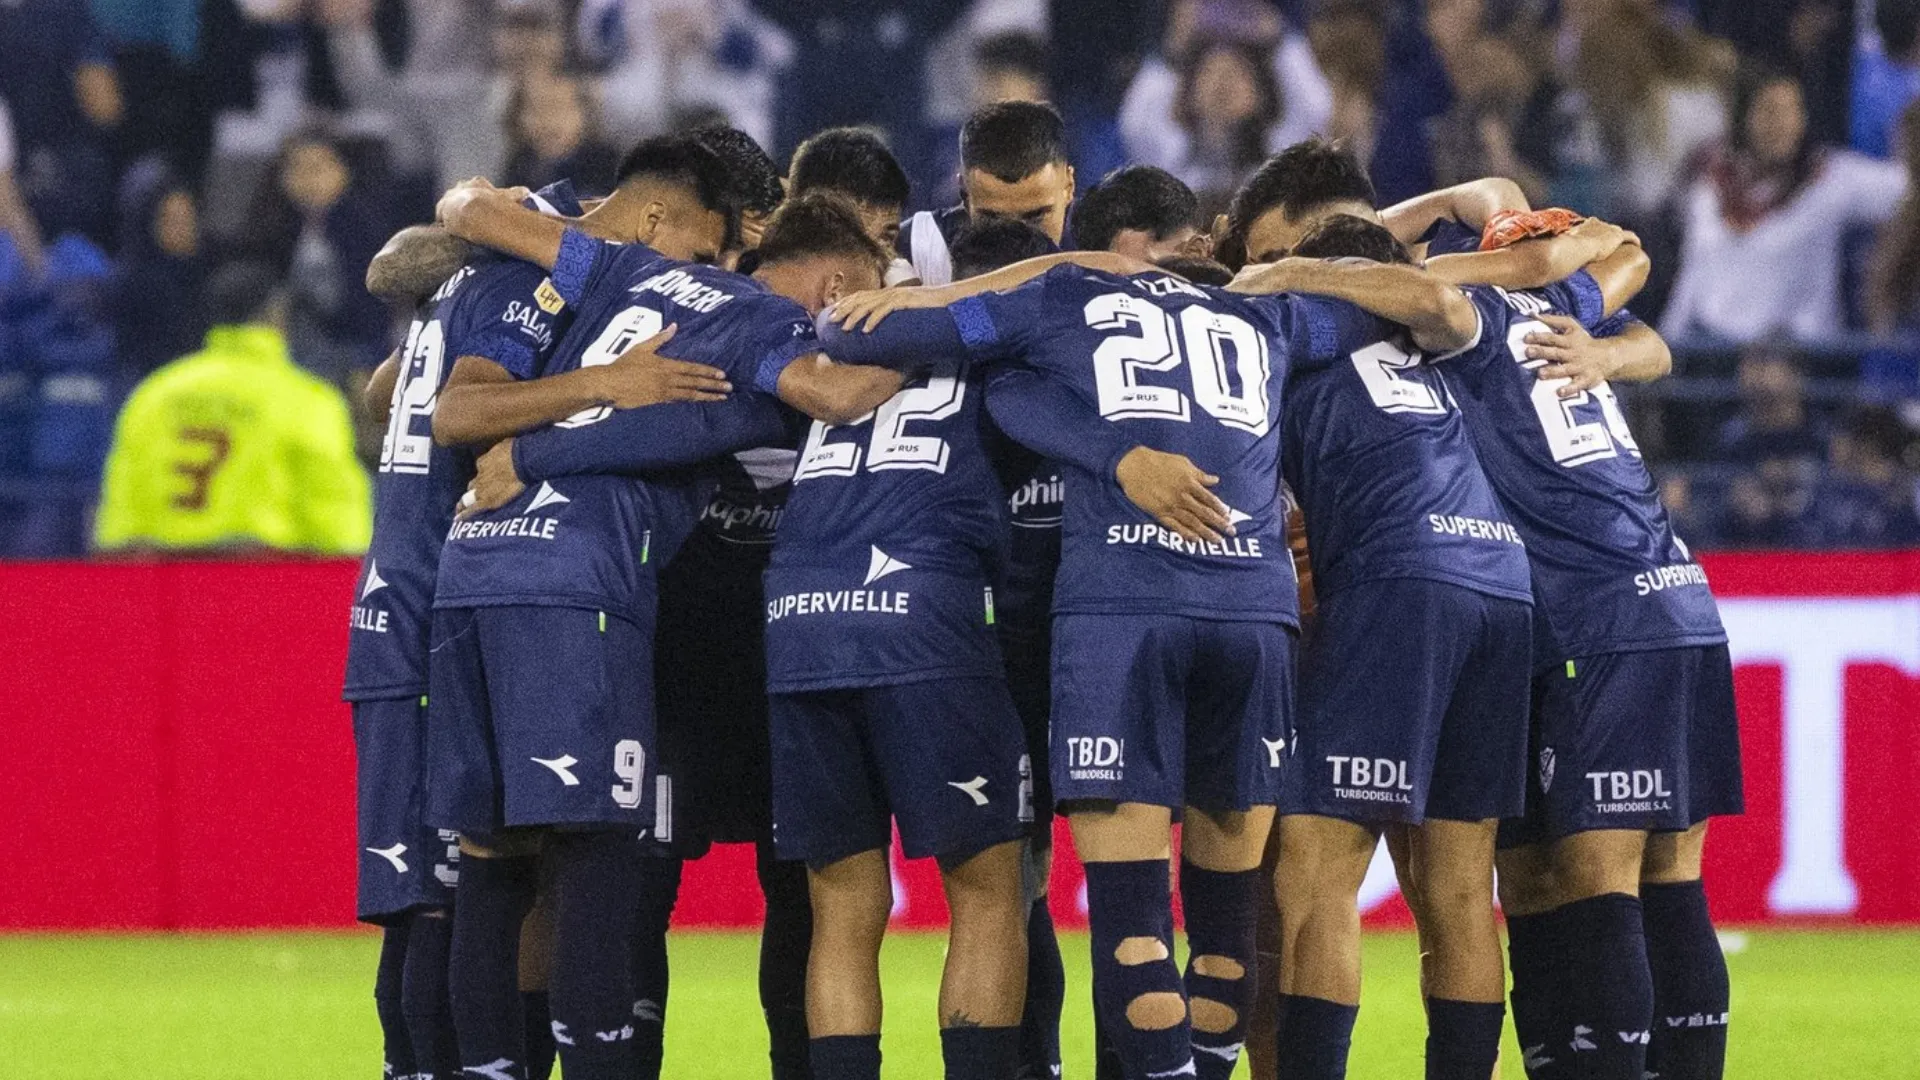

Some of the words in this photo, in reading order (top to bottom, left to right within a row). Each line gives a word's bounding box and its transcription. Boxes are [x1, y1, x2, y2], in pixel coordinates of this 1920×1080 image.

[1084, 292, 1271, 437] 20
[1136, 393, 1158, 402] RUS
[816, 451, 835, 461] RUS
[897, 443, 919, 454] RUS
[168, 426, 231, 513] 3
[1106, 524, 1263, 558] SUPERVIELLE
[1429, 513, 1525, 547] SUPERVIE
[767, 590, 910, 624] SUPERVIELLE
[611, 739, 645, 808] 9
[1326, 755, 1413, 791] TBDL
[1585, 768, 1672, 801] TBDL
[1334, 788, 1394, 802] TURBODISEL
